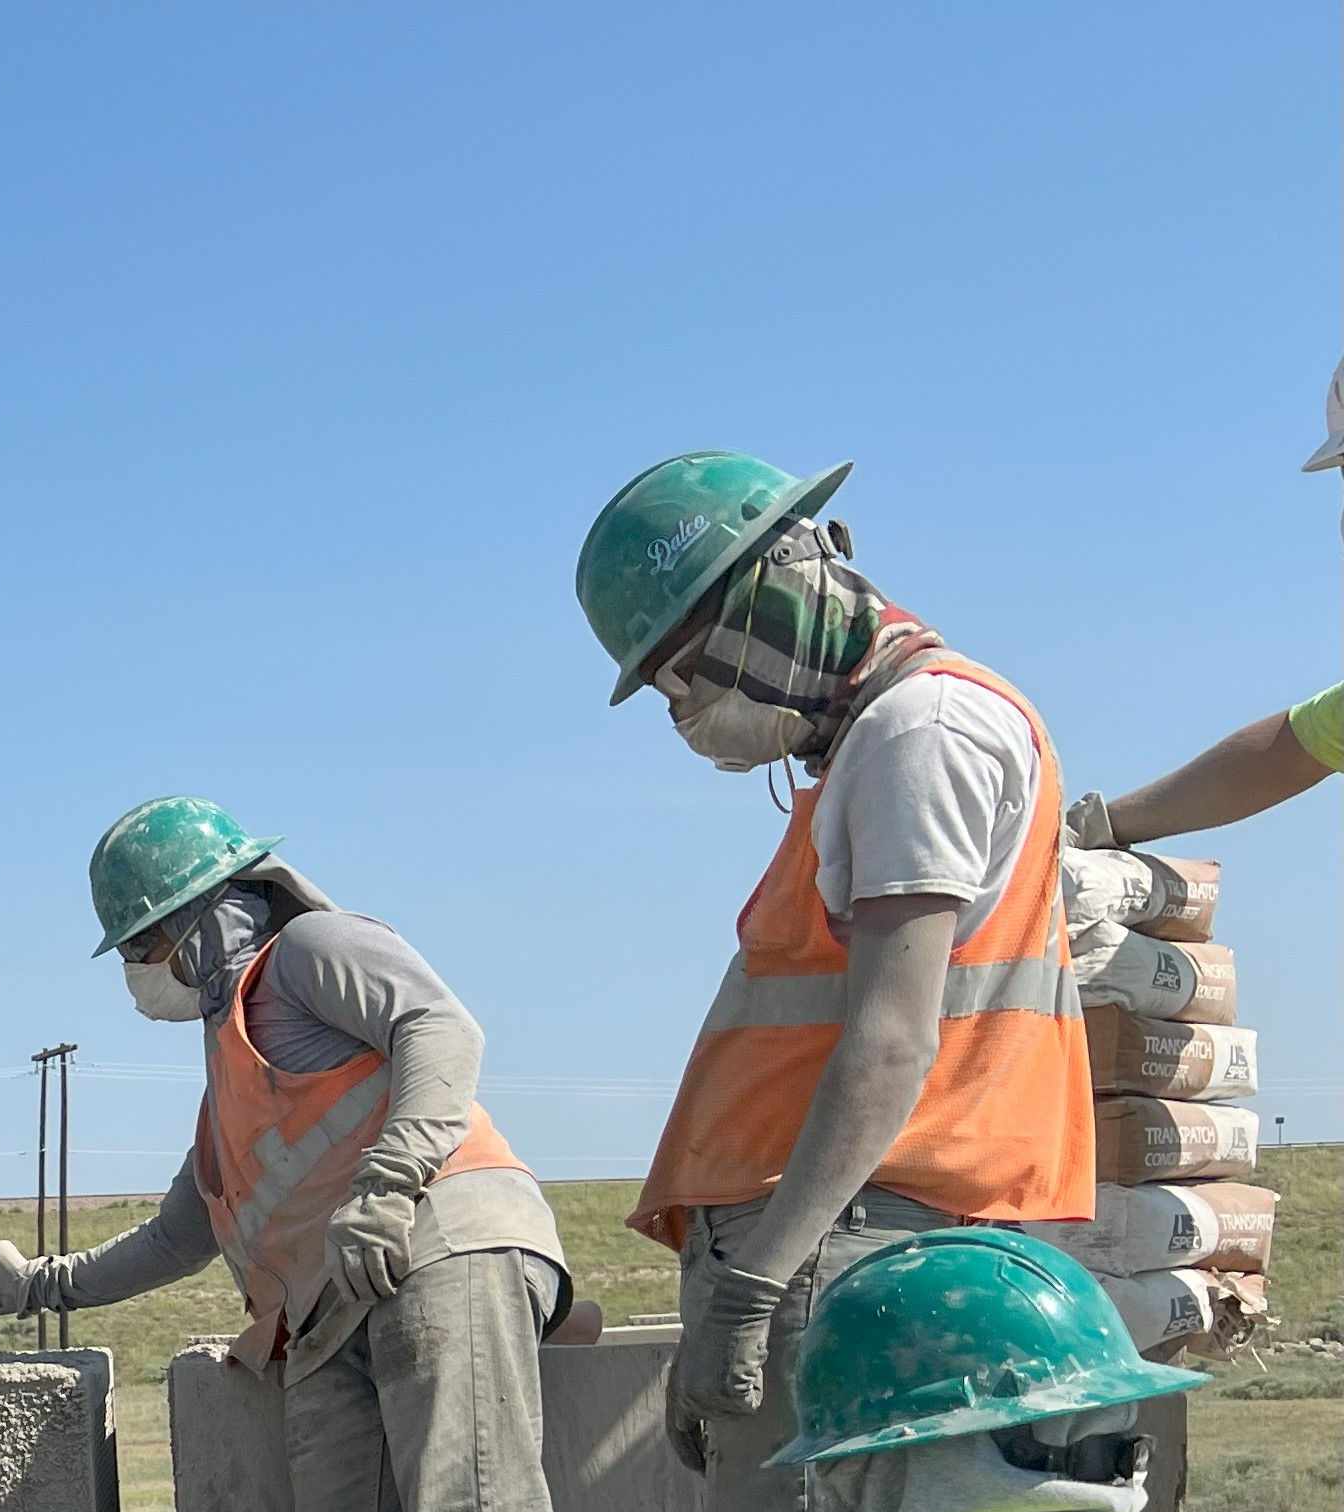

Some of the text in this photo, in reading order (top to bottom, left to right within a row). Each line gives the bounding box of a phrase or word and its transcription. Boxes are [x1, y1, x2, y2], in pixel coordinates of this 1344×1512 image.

[1155, 972, 1180, 989] SPEC
[1144, 1036, 1212, 1060] TRANSPATCH
[1145, 1127, 1216, 1145] TRANSPATCH
[1219, 1213, 1273, 1231] TRANSPATC
[1169, 1236, 1201, 1250] SPEC
[1165, 1317, 1202, 1334] SPEC
